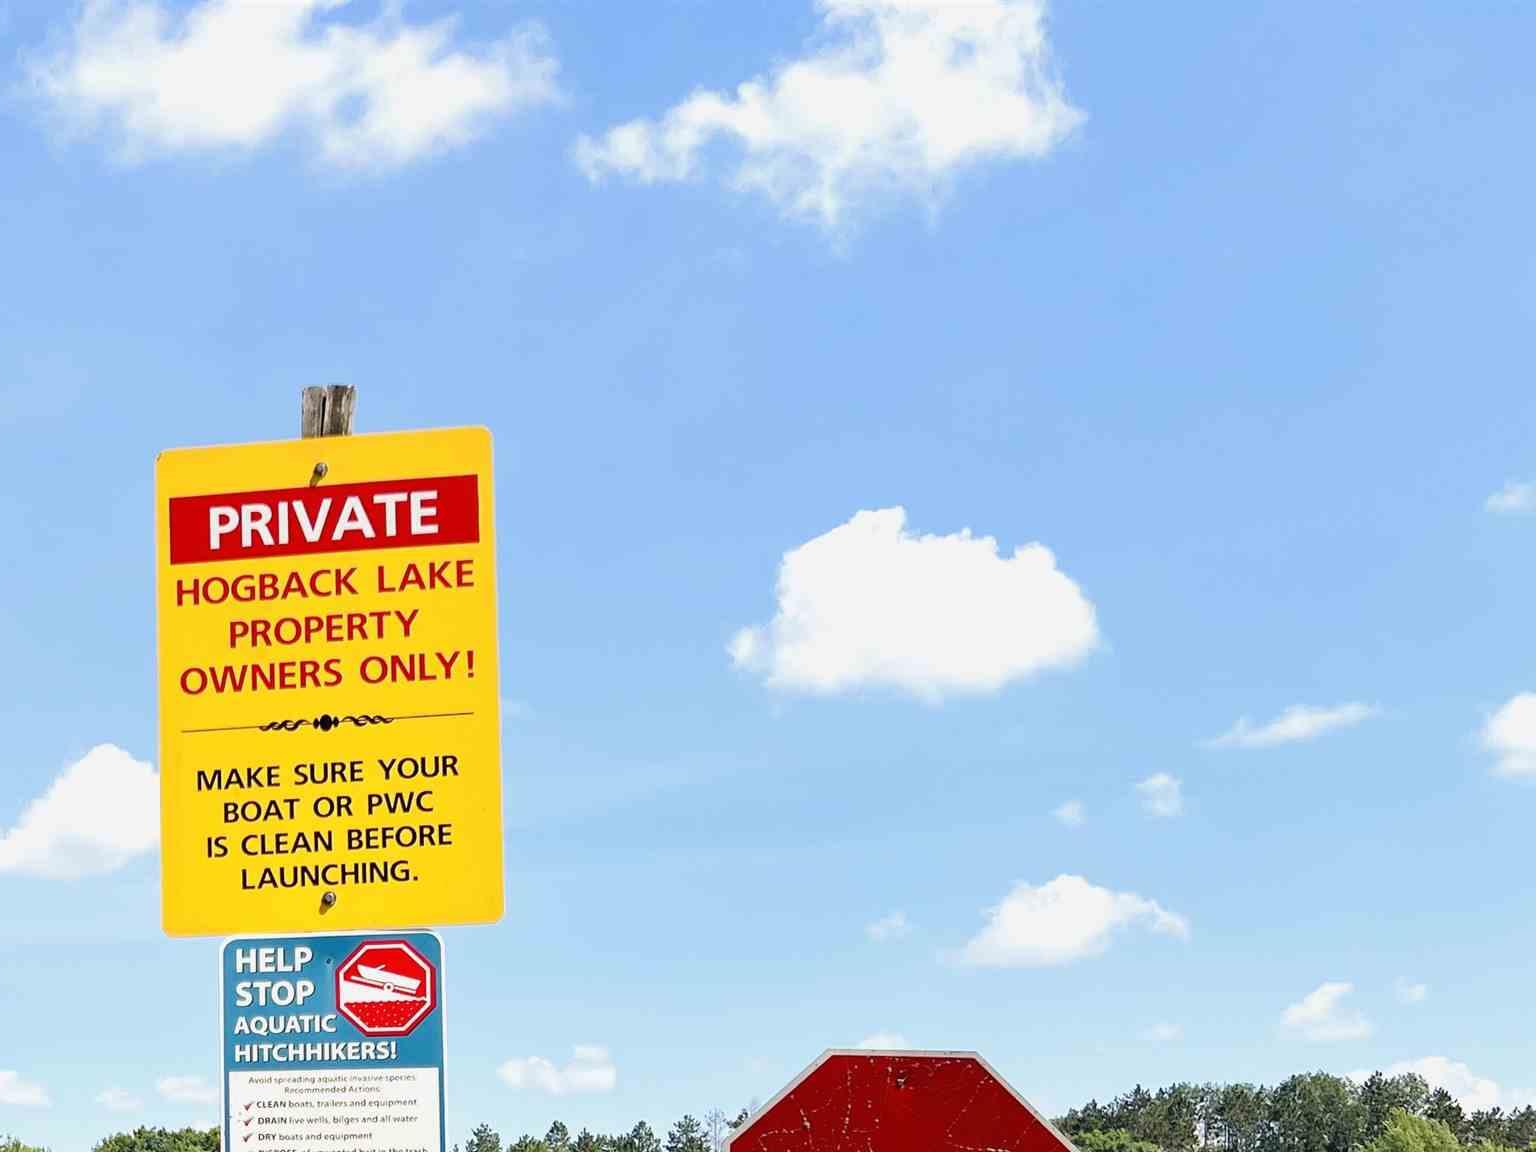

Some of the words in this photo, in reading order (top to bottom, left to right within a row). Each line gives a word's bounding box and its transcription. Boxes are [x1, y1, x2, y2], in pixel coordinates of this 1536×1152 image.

[209, 489, 439, 550] PRIVATE
[176, 567, 358, 607] HOGBACK
[378, 559, 474, 594] LAKE
[229, 609, 419, 648] PROPERTY
[180, 658, 342, 695] OWNERS
[360, 650, 474, 684] ONLY!
[197, 765, 280, 791] MAKE
[294, 760, 363, 786] SURE
[378, 755, 459, 781] YOUR
[223, 798, 300, 823] BOAT
[314, 795, 352, 819] OR
[367, 791, 434, 816] PWC
[207, 836, 229, 858] IS
[241, 830, 333, 856] CLEAN
[347, 824, 453, 850] BEFORE
[241, 860, 419, 890] LAUNCHING.
[235, 947, 313, 973] HELP
[235, 980, 315, 1007] STOP
[233, 1014, 337, 1036] AQUATIC
[234, 1041, 398, 1063] HITCHHIKERS!
[248, 1076, 272, 1085] Avoid
[317, 1075, 347, 1084] aquatic
[284, 1086, 346, 1094] Recommended
[256, 1100, 286, 1108] CLEAN
[316, 1099, 347, 1108] trailers
[349, 1098, 366, 1107] and
[368, 1098, 417, 1108] equipment
[257, 1117, 287, 1125] DRAIN
[289, 1116, 305, 1124] live
[332, 1115, 360, 1125] bilges
[361, 1115, 378, 1123] and
[380, 1114, 391, 1123] all
[392, 1115, 418, 1123] water
[258, 1133, 277, 1141] DRY
[278, 1132, 303, 1141] boats
[305, 1132, 322, 1140] and
[324, 1132, 373, 1142] equipment
